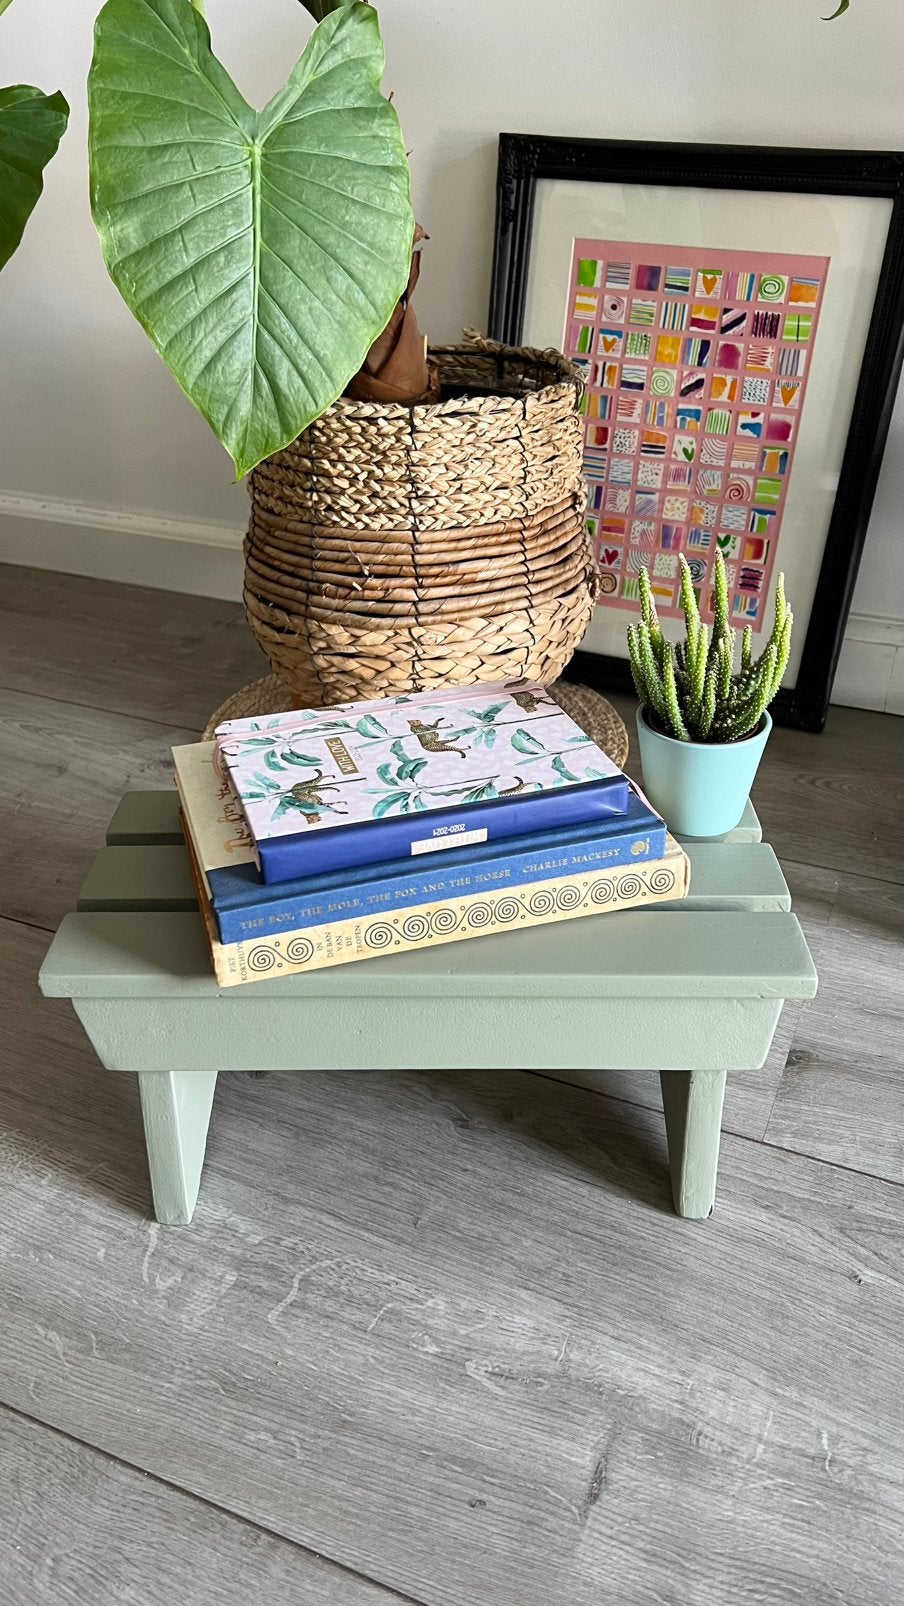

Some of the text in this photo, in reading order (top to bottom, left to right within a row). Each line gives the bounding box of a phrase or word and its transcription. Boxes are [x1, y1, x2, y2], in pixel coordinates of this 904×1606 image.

[328, 740, 348, 757] LOVE
[336, 757, 356, 772] WITH
[433, 823, 466, 836] 2020-2021
[241, 848, 621, 930] THE BOY, THE MOLE, THE FOX AND THE HORSE CHARLIE MACKESY
[316, 942, 323, 951] IN
[324, 931, 334, 958] DE BAN
[345, 936, 353, 947] DE
[354, 925, 364, 953] TROPEN
[228, 957, 237, 973] PIET
